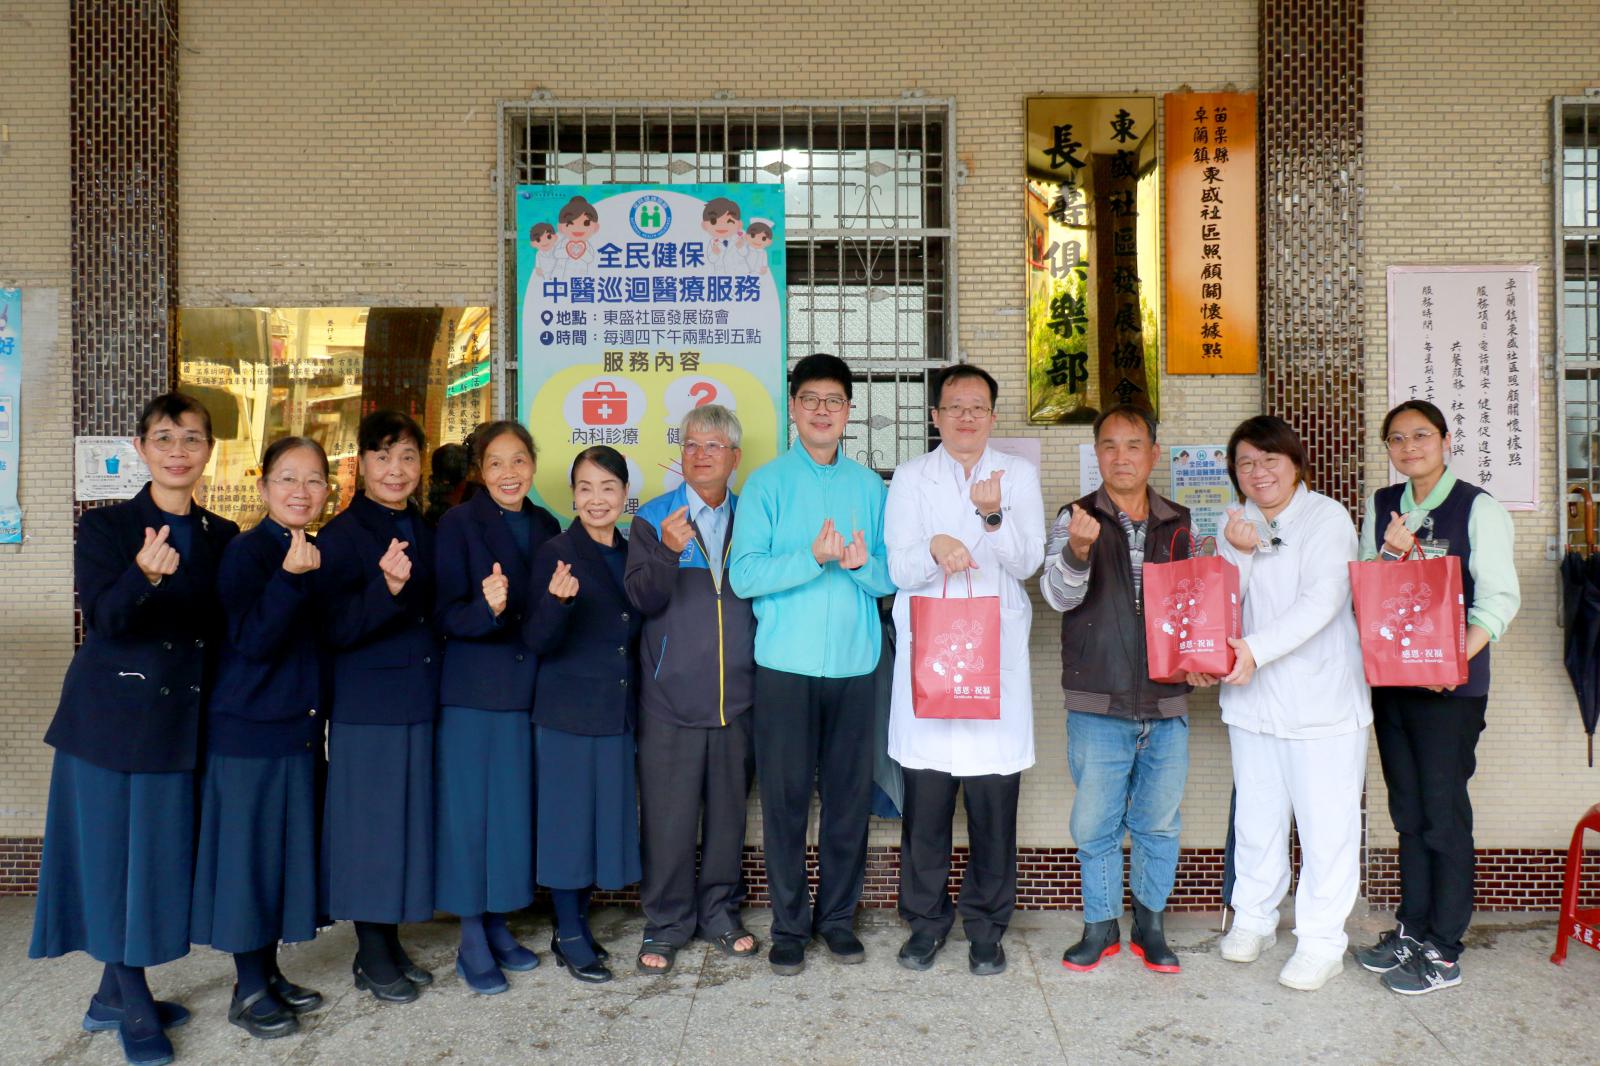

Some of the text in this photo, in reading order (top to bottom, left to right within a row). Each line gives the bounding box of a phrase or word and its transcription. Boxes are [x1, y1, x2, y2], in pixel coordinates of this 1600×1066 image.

[1193, 106, 1209, 164] 卓蘭鎮
[1214, 107, 1229, 163] 苗栗縣
[597, 242, 705, 269] 全民健保
[1044, 123, 1089, 394] 長壽俱樂部
[1200, 167, 1224, 359] 東盛社區照顧關懷據點
[543, 276, 761, 303] 中醫巡迴醫療服務
[603, 351, 700, 372] 服務內容
[572, 427, 639, 445] 內科診療
